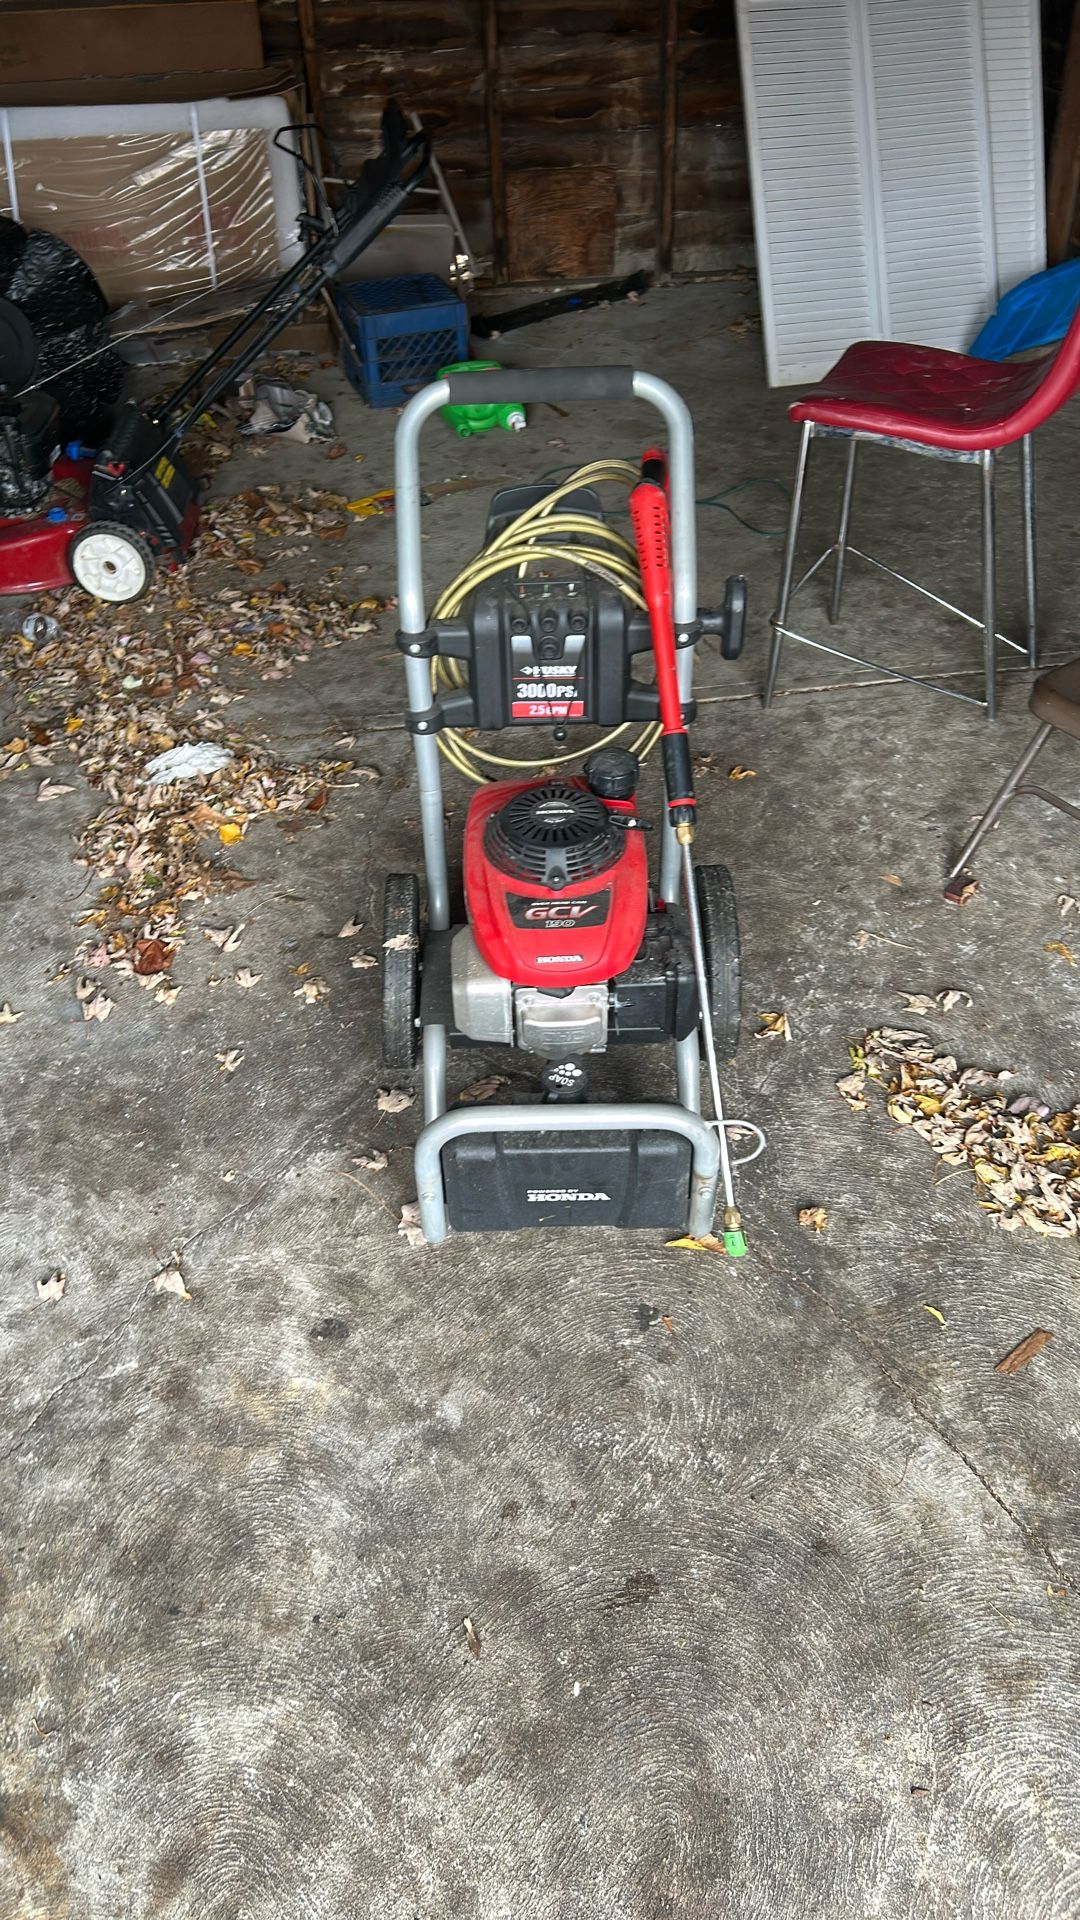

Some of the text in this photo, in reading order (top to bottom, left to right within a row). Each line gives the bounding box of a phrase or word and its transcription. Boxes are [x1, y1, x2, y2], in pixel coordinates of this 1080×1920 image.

[532, 665, 578, 677] HUSKY
[524, 905, 599, 920] GCV
[536, 955, 584, 964] HONDA
[548, 1073, 576, 1087] SOAP
[527, 1193, 611, 1202] HONDA
